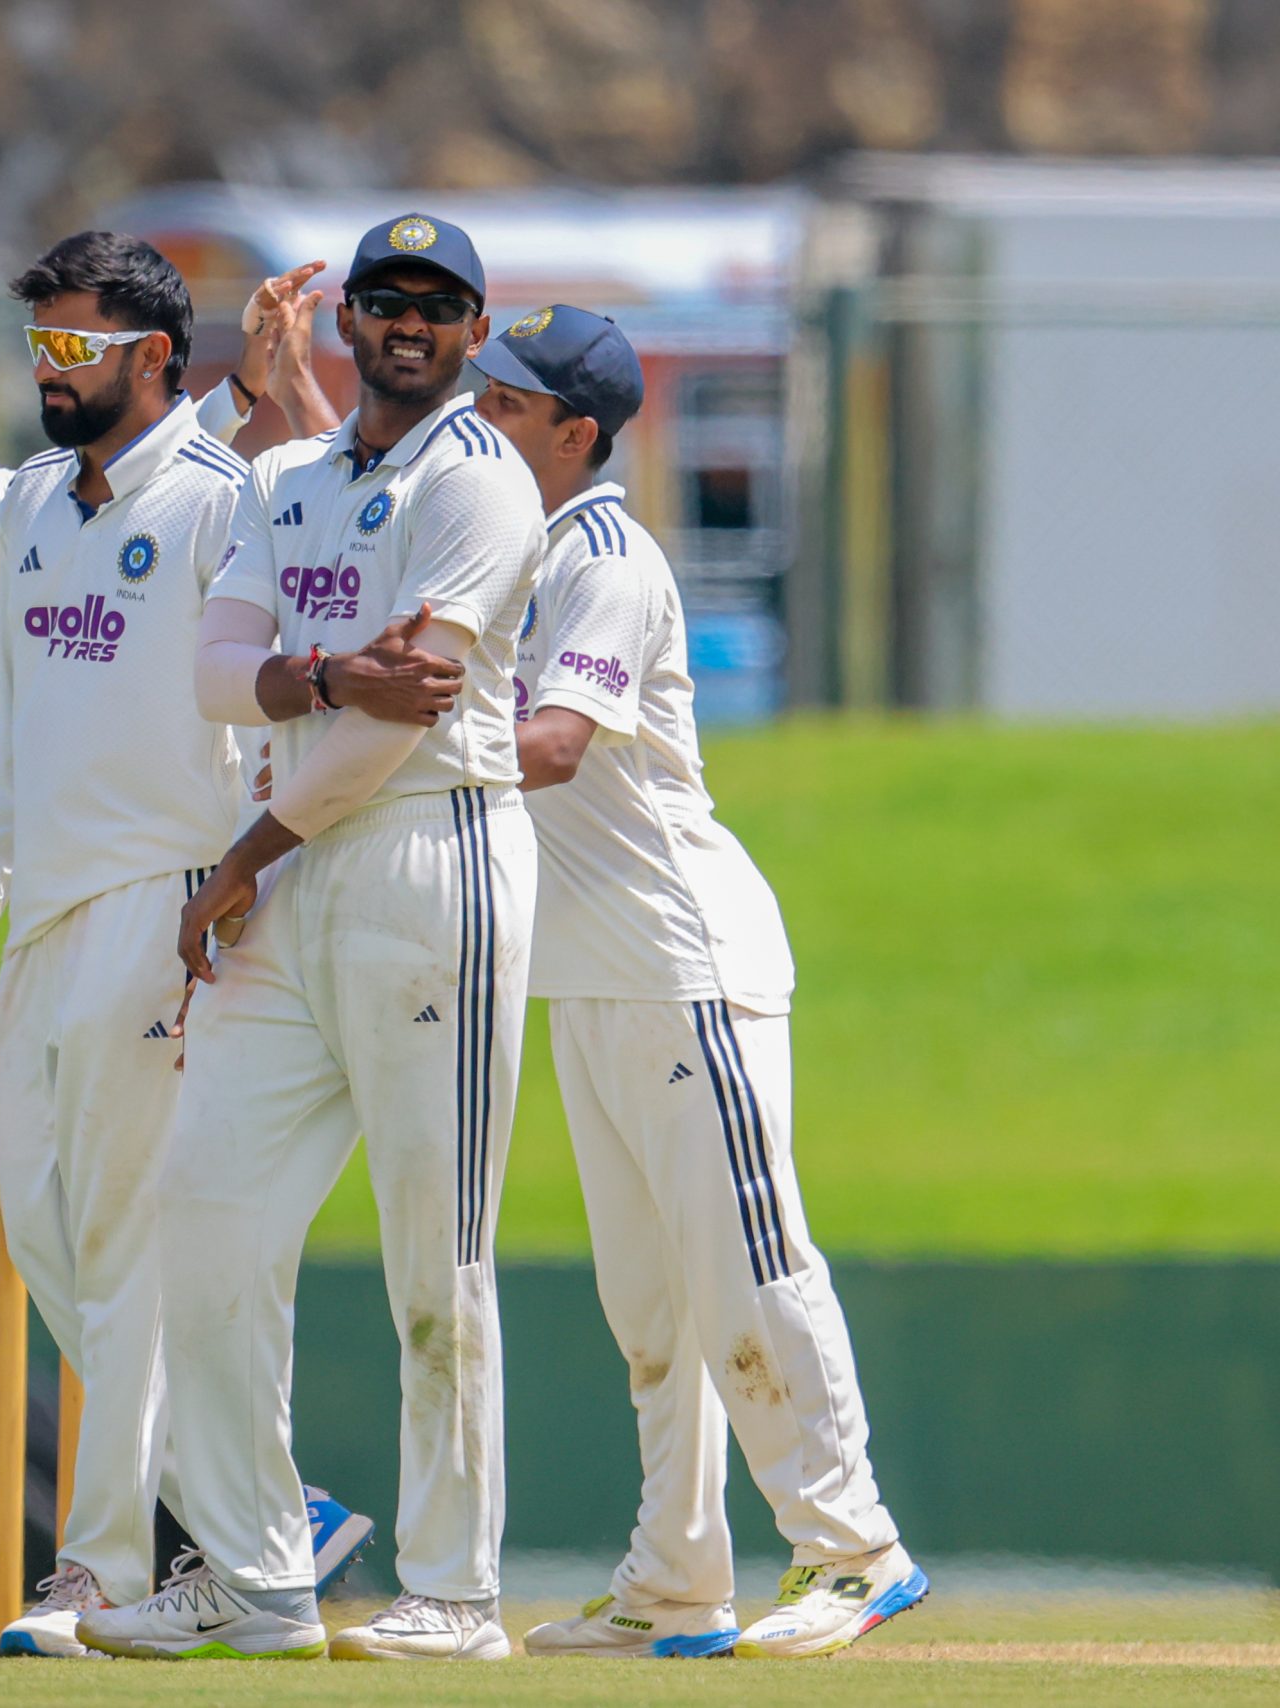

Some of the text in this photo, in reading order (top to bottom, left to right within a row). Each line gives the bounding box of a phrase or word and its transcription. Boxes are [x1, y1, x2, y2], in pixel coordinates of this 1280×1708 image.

[116, 588, 146, 603] INDIA-A
[47, 638, 119, 663] TYRES
[558, 650, 630, 689] apollo
[585, 671, 624, 698] TYRES
[610, 1615, 653, 1630] LOTTO
[761, 1628, 797, 1640] LOTTO
